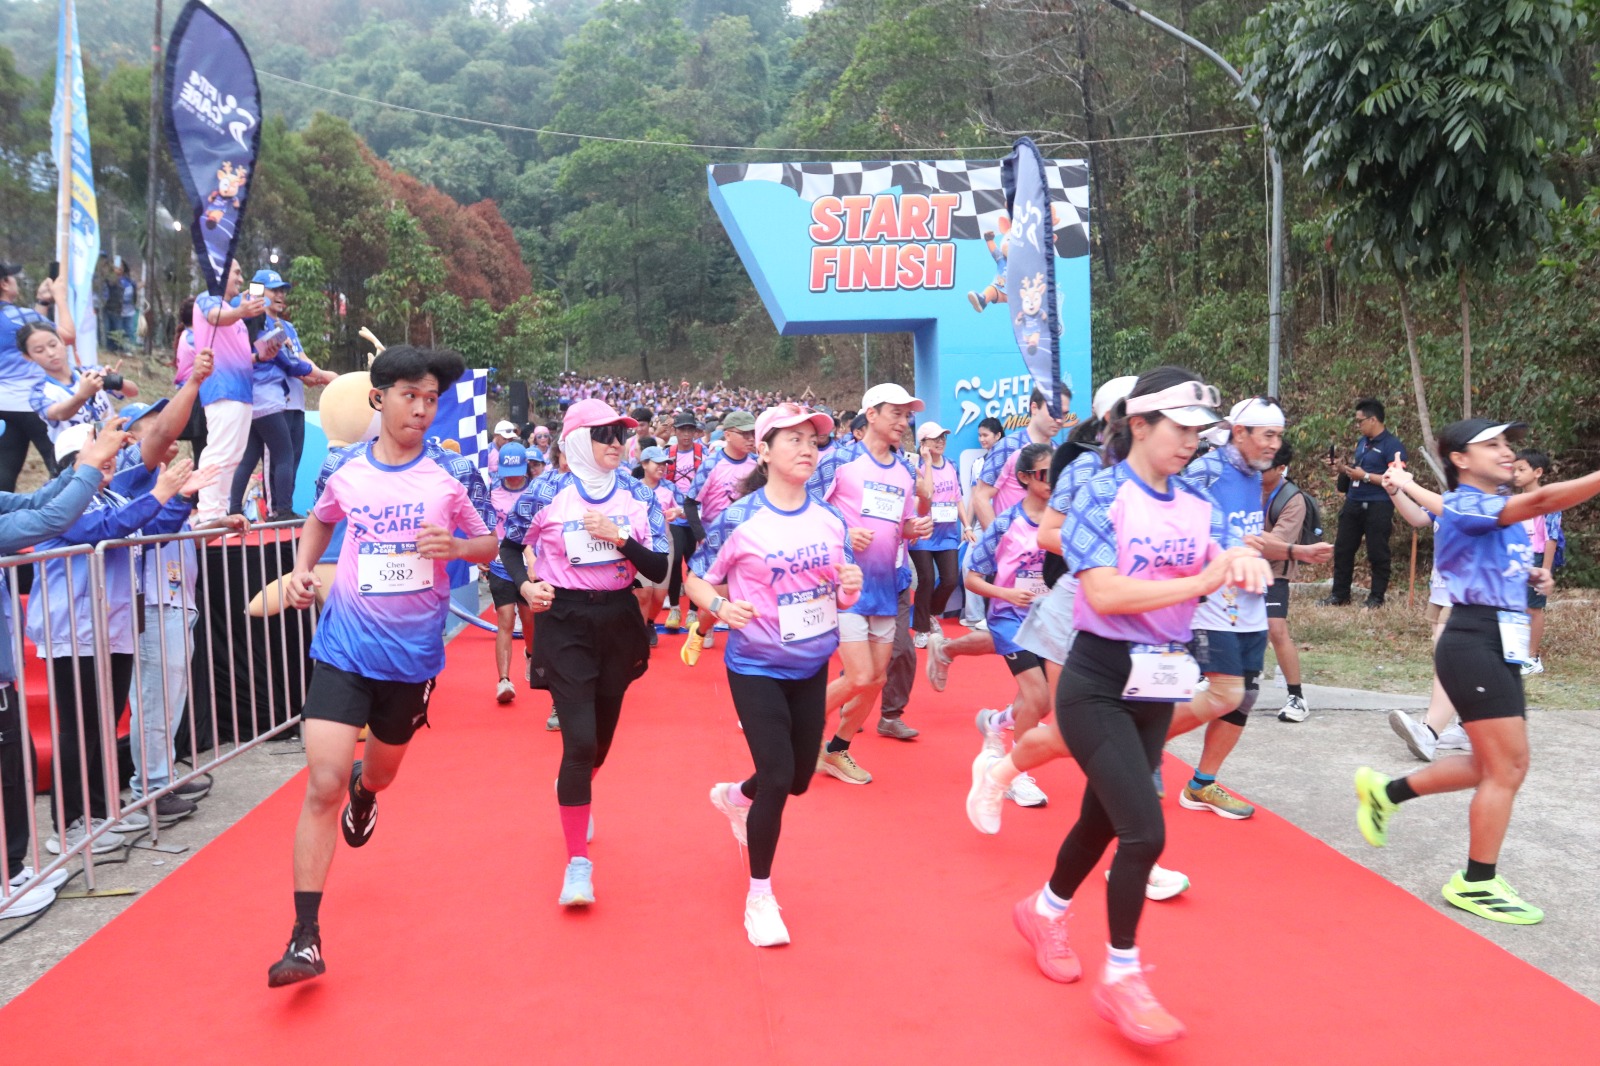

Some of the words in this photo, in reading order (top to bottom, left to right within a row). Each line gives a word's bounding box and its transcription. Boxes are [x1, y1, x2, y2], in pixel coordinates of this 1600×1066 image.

[809, 193, 961, 243] START
[809, 243, 955, 292] FINISH
[998, 374, 1035, 398] FIT
[384, 502, 425, 519] FIT4
[373, 516, 425, 534] CARE
[587, 542, 615, 552] 5016
[797, 542, 828, 559] FIT4
[1164, 537, 1196, 553] FIT4
[790, 554, 830, 574] CARE
[1154, 552, 1196, 568] CARE
[379, 569, 413, 581] 5282
